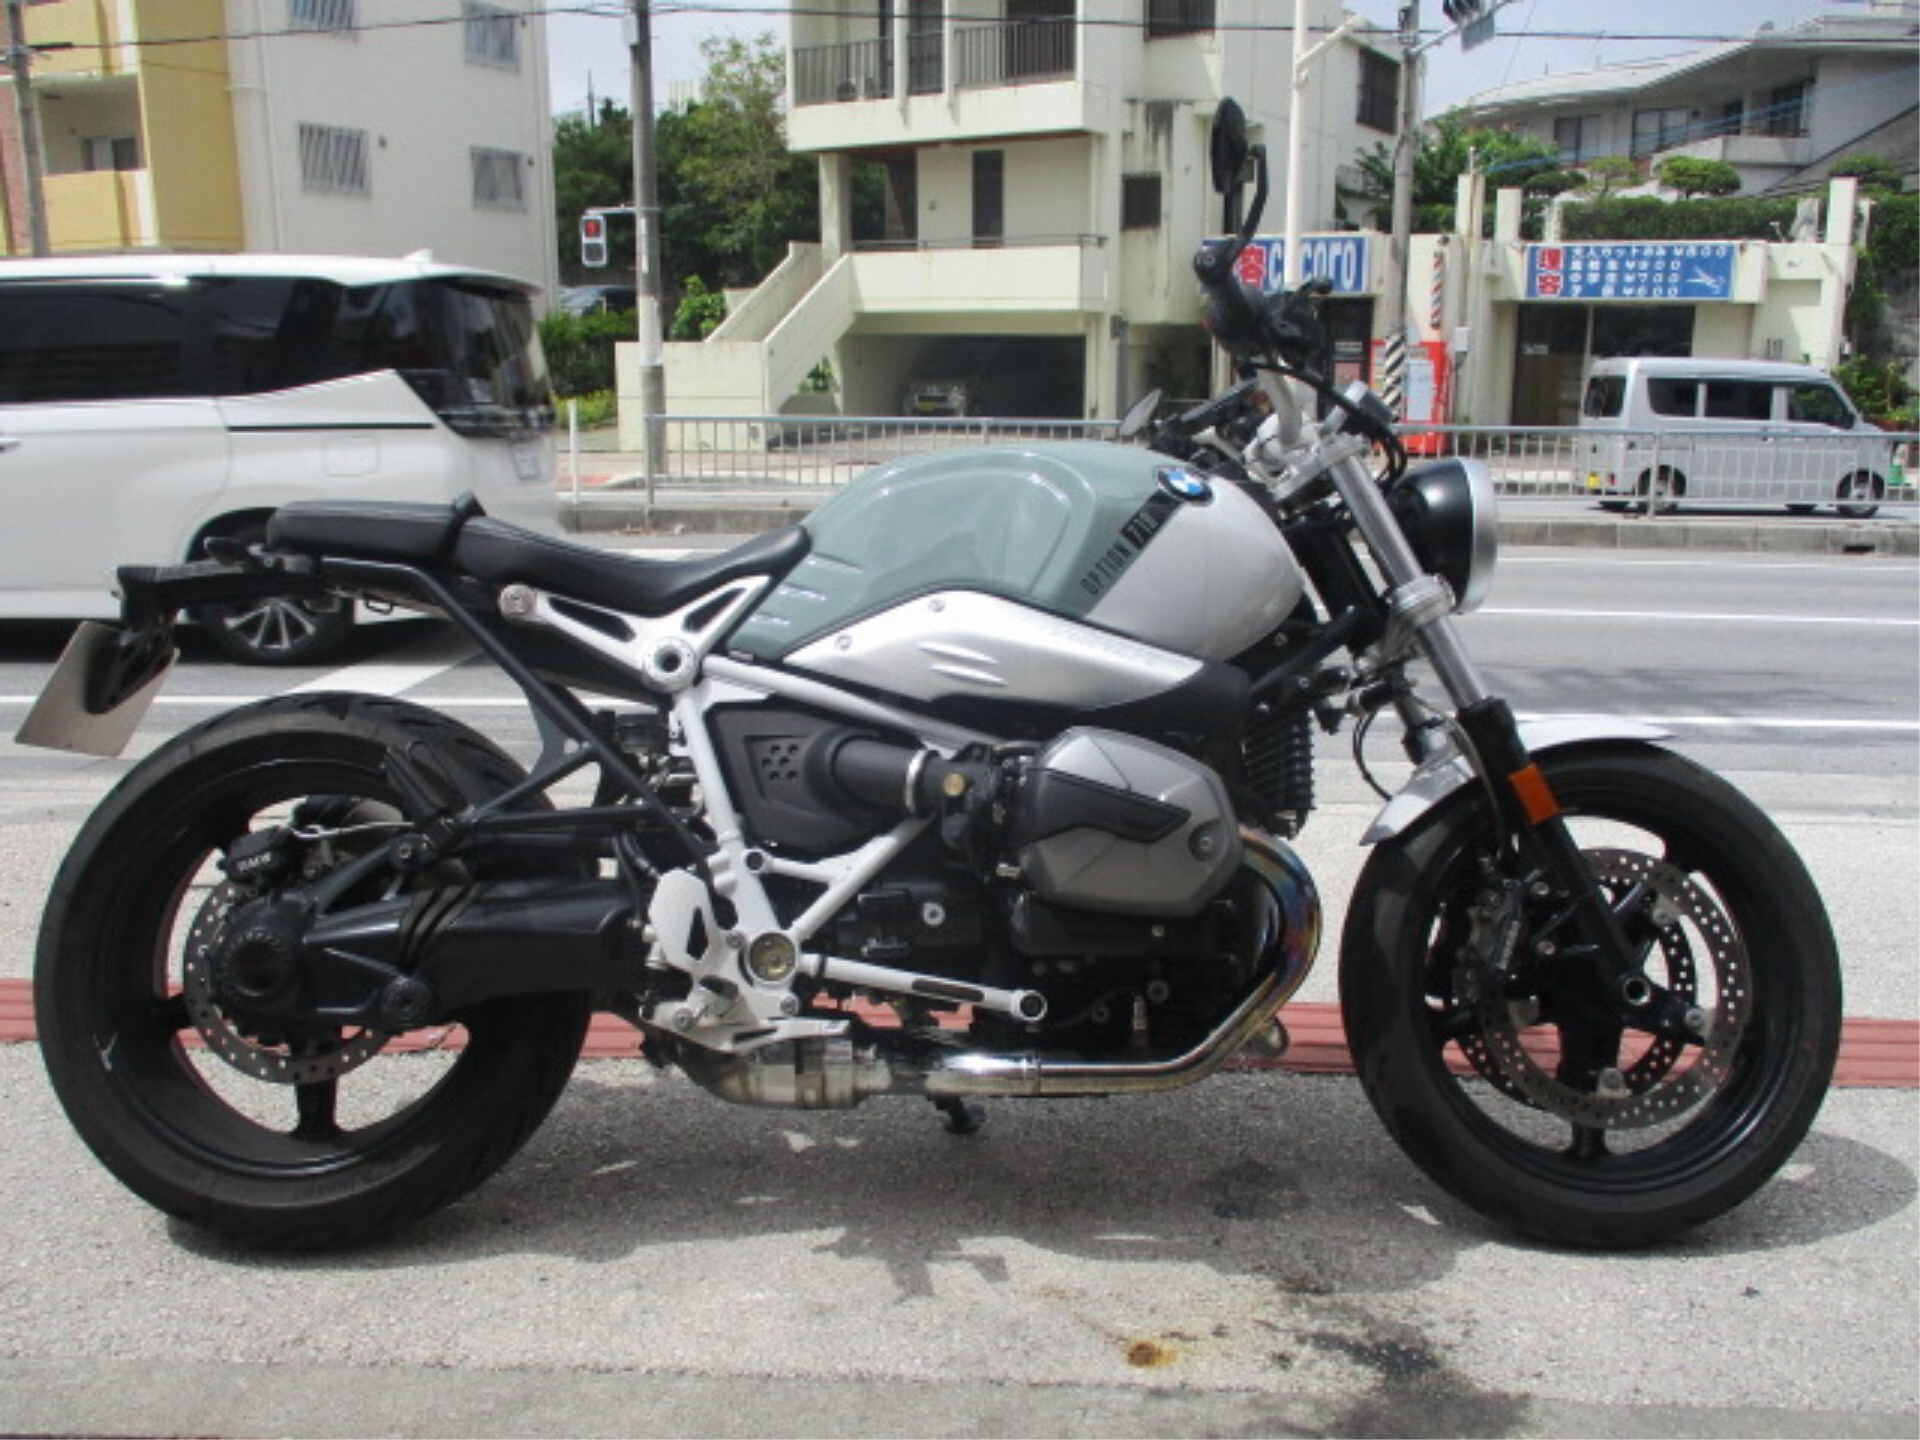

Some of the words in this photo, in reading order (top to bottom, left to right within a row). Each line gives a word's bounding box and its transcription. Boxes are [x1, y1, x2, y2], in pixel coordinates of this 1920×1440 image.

[1269, 242, 1357, 290] ccoro
[1536, 247, 1564, 296] 理容
[1079, 540, 1132, 595] OPTION
